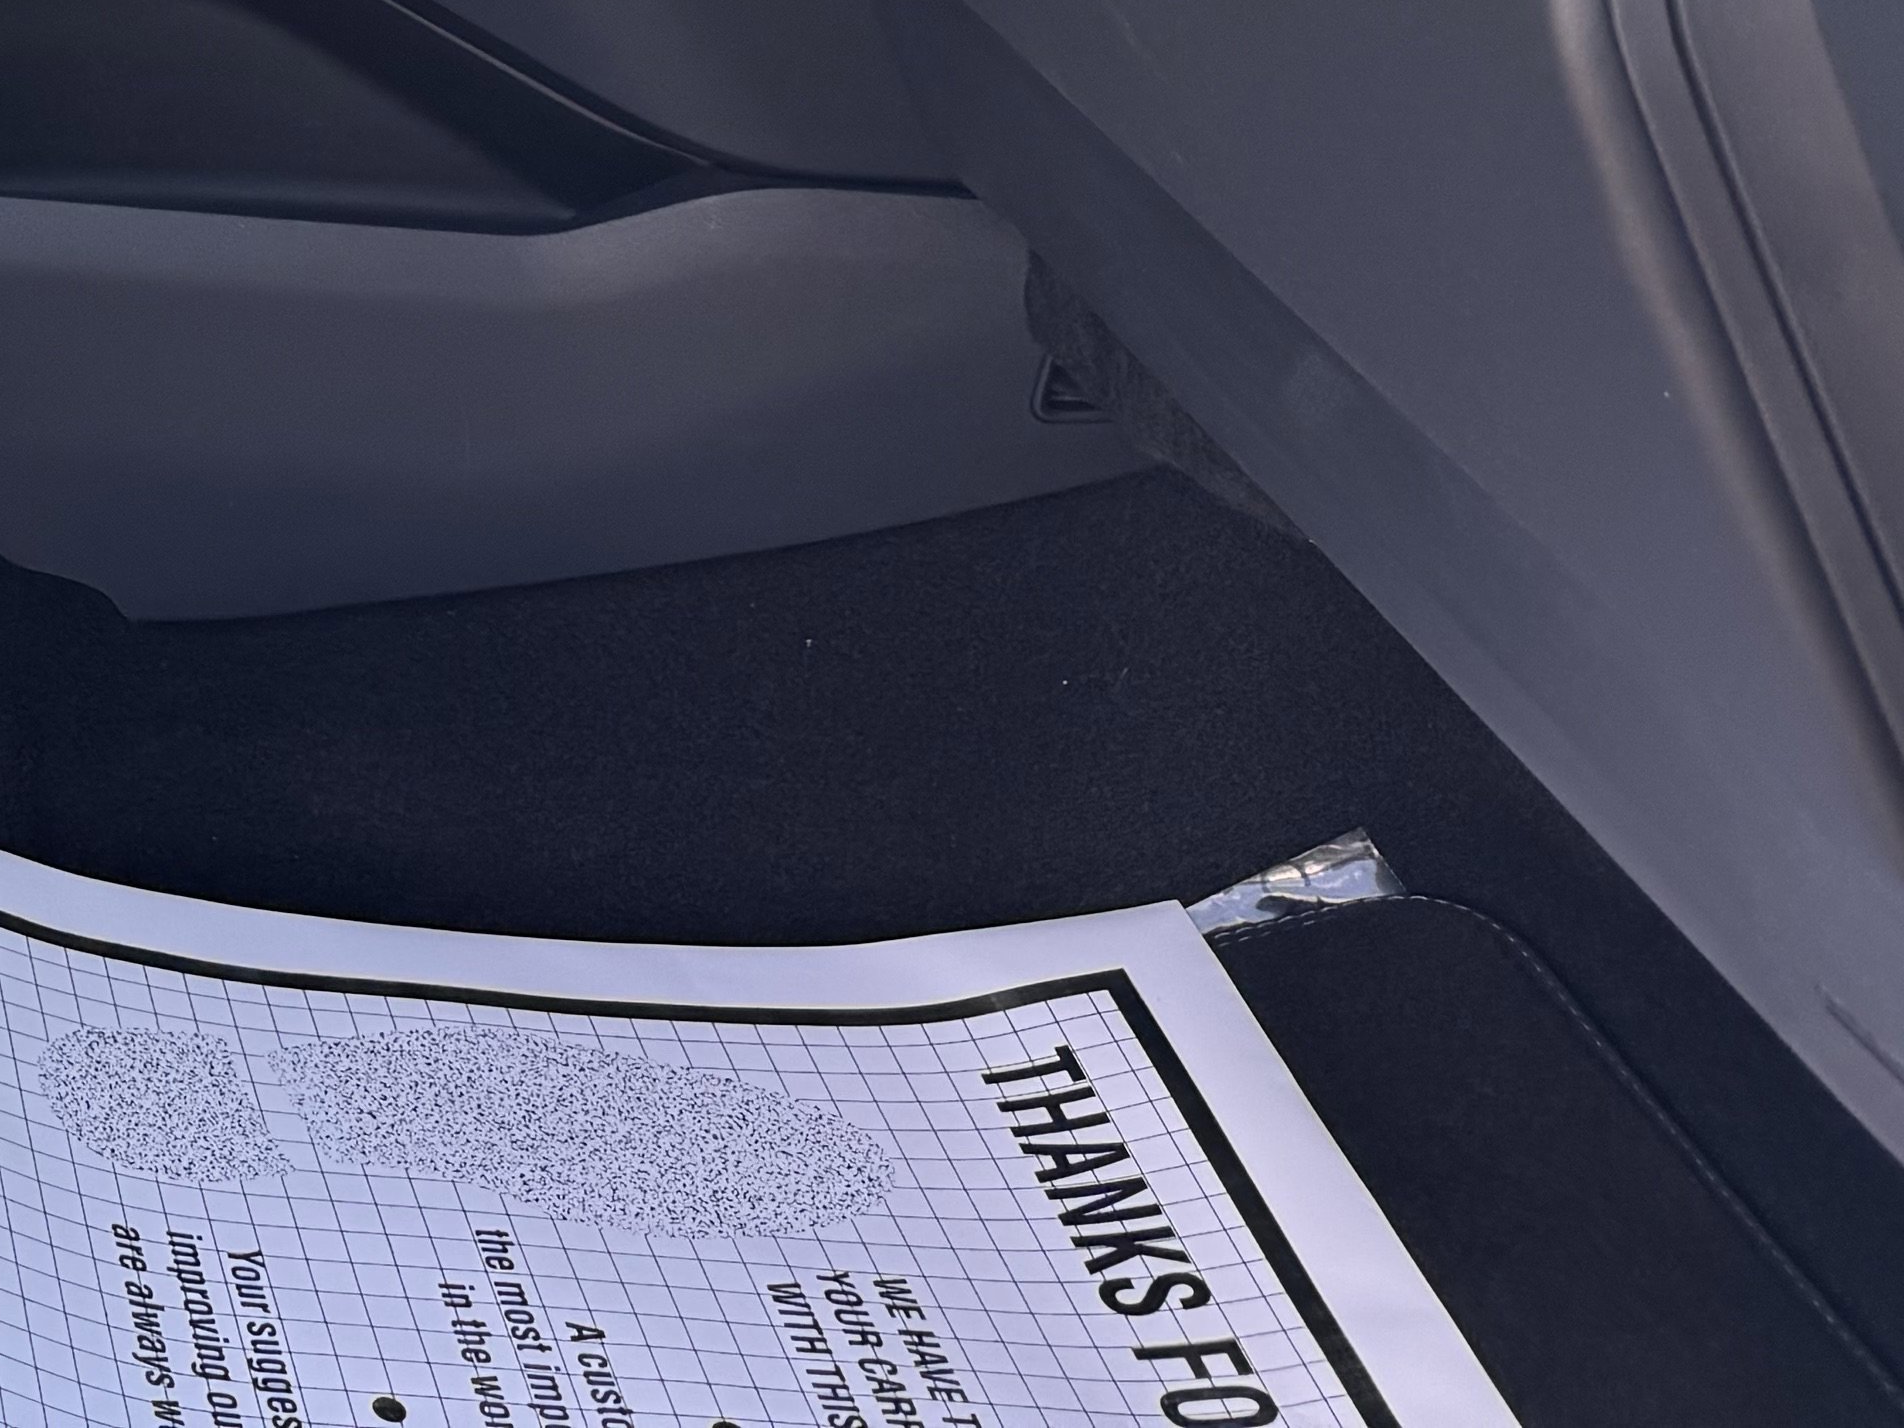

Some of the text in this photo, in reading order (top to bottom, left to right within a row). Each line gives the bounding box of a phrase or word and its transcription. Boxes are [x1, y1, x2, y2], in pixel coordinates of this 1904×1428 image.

[980, 1045, 1212, 1317] THANKS
[111, 1223, 147, 1272] are
[226, 1249, 272, 1314] Your
[165, 1229, 231, 1382] improving
[438, 1282, 476, 1309] in
[475, 1229, 571, 1428] the most imp
[564, 1320, 606, 1343] A
[816, 1271, 884, 1348] YOUR
[872, 1278, 927, 1321] WE
[124, 1280, 176, 1389] always
[451, 1319, 492, 1365] the
[766, 1282, 869, 1428] WITH THIS
[897, 1328, 970, 1403] HAVE
